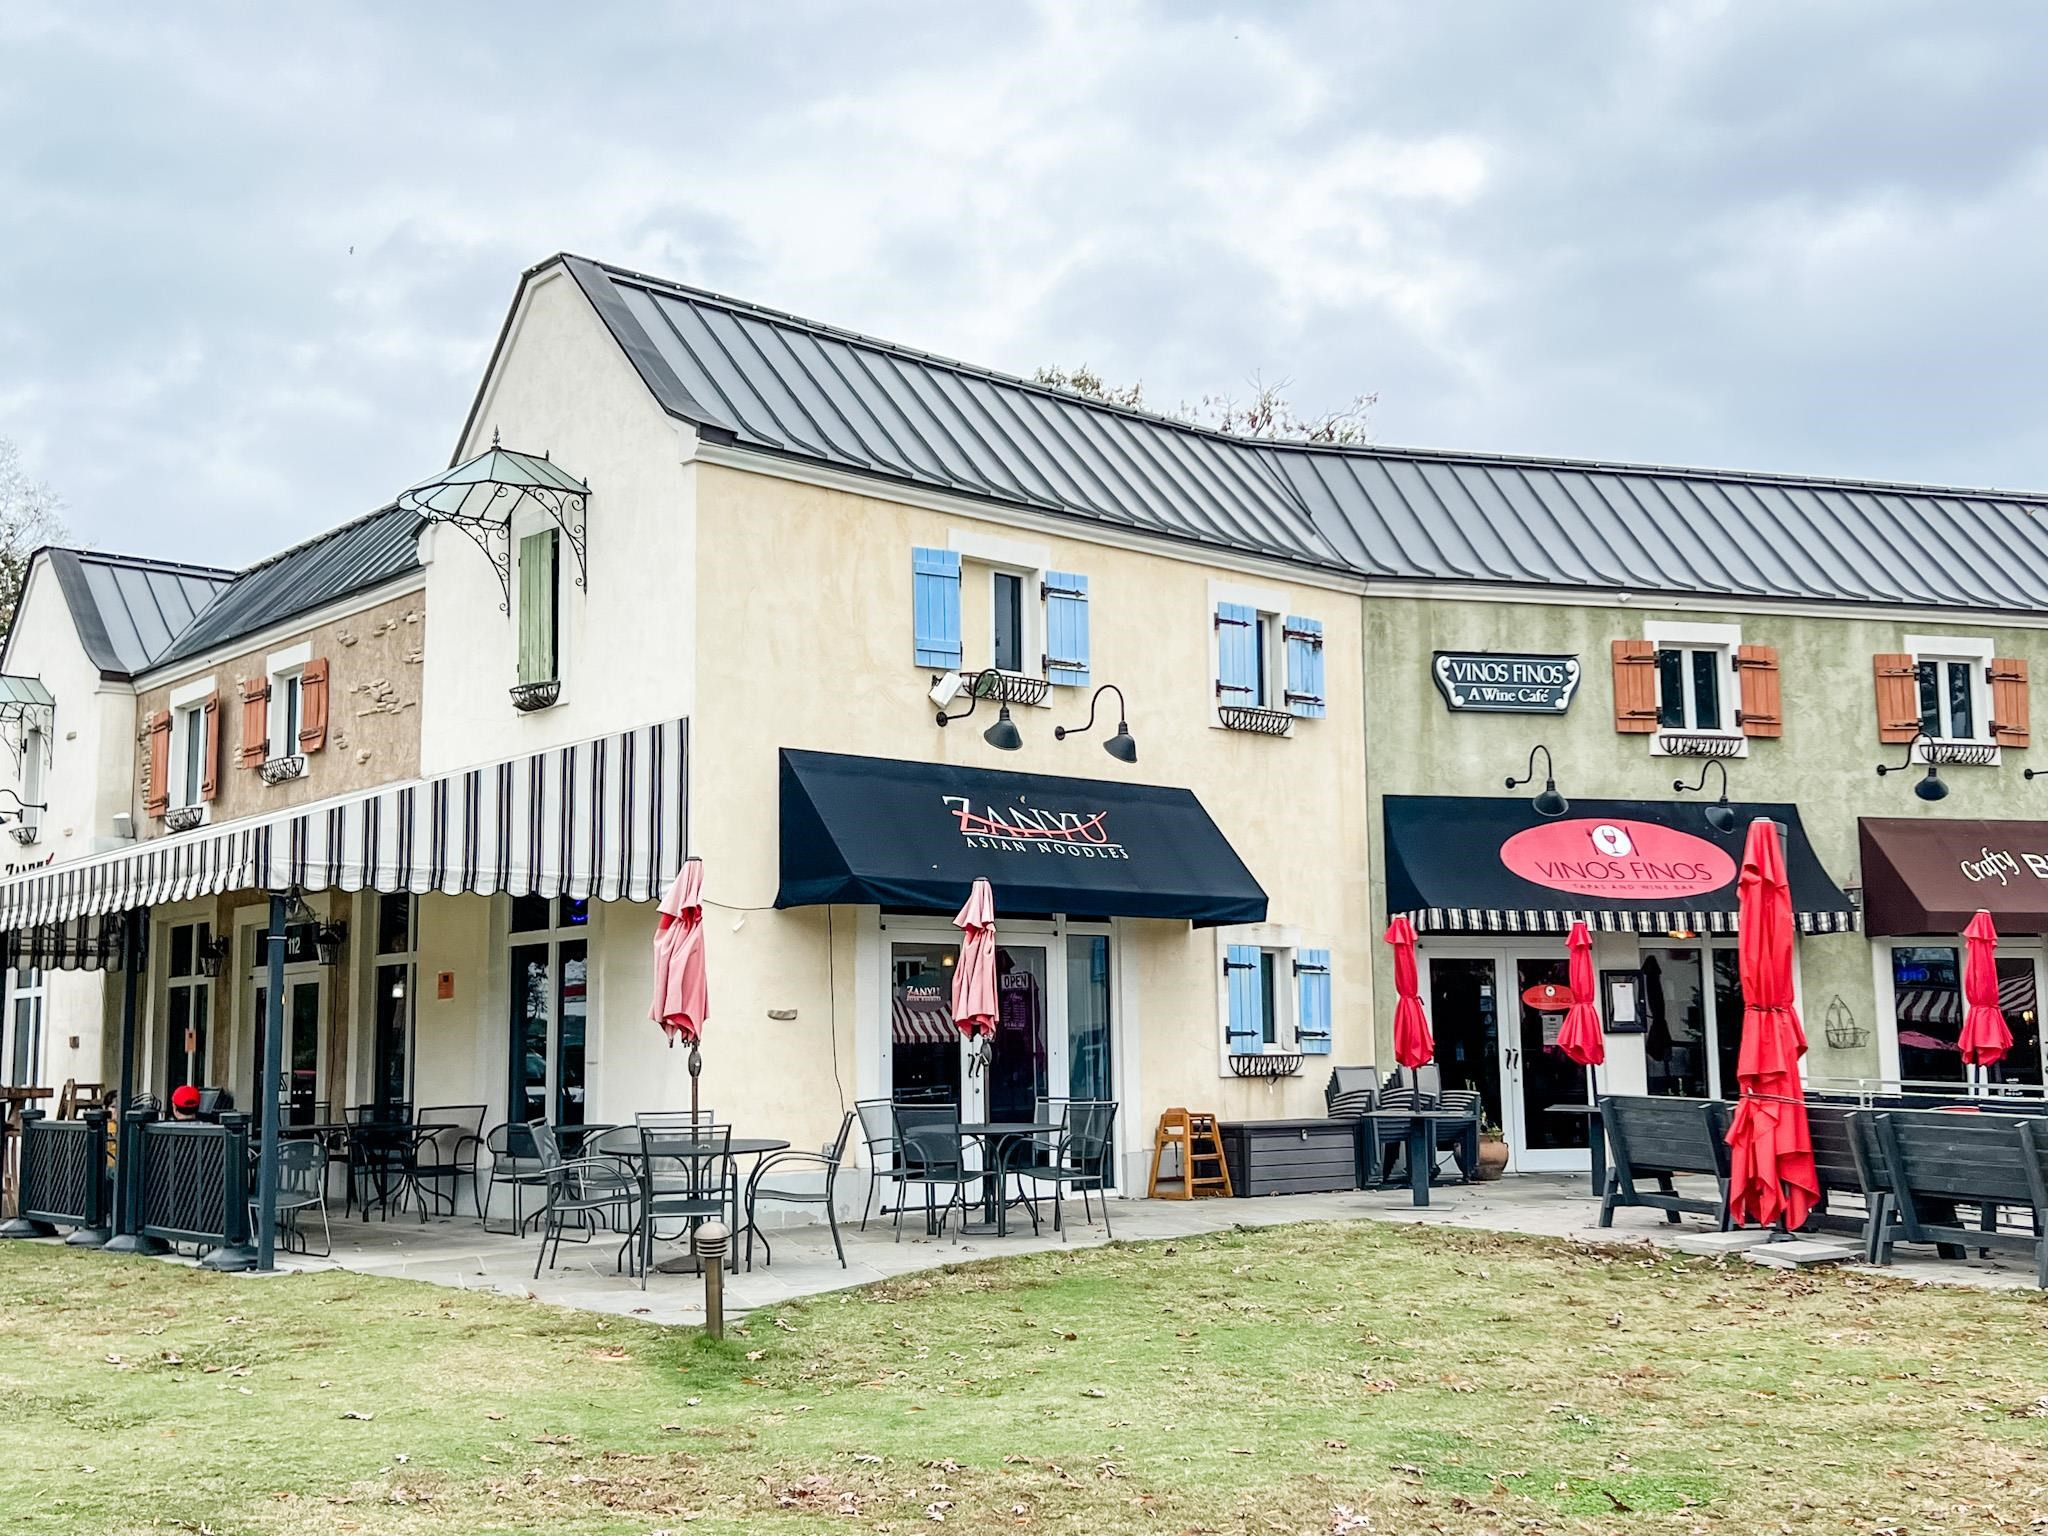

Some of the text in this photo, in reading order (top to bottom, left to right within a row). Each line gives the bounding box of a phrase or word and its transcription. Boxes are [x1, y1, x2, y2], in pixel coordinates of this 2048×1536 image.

[1452, 662, 1564, 684] VINOS FINOS
[1468, 687, 1550, 703] A Wine Café
[966, 836, 1129, 860] ASIAN NOODLES
[1534, 861, 1713, 881] VINOS FINOS
[1960, 847, 2048, 886] Crafty B
[288, 936, 300, 955] 112
[1004, 974, 1027, 988] OPEN
